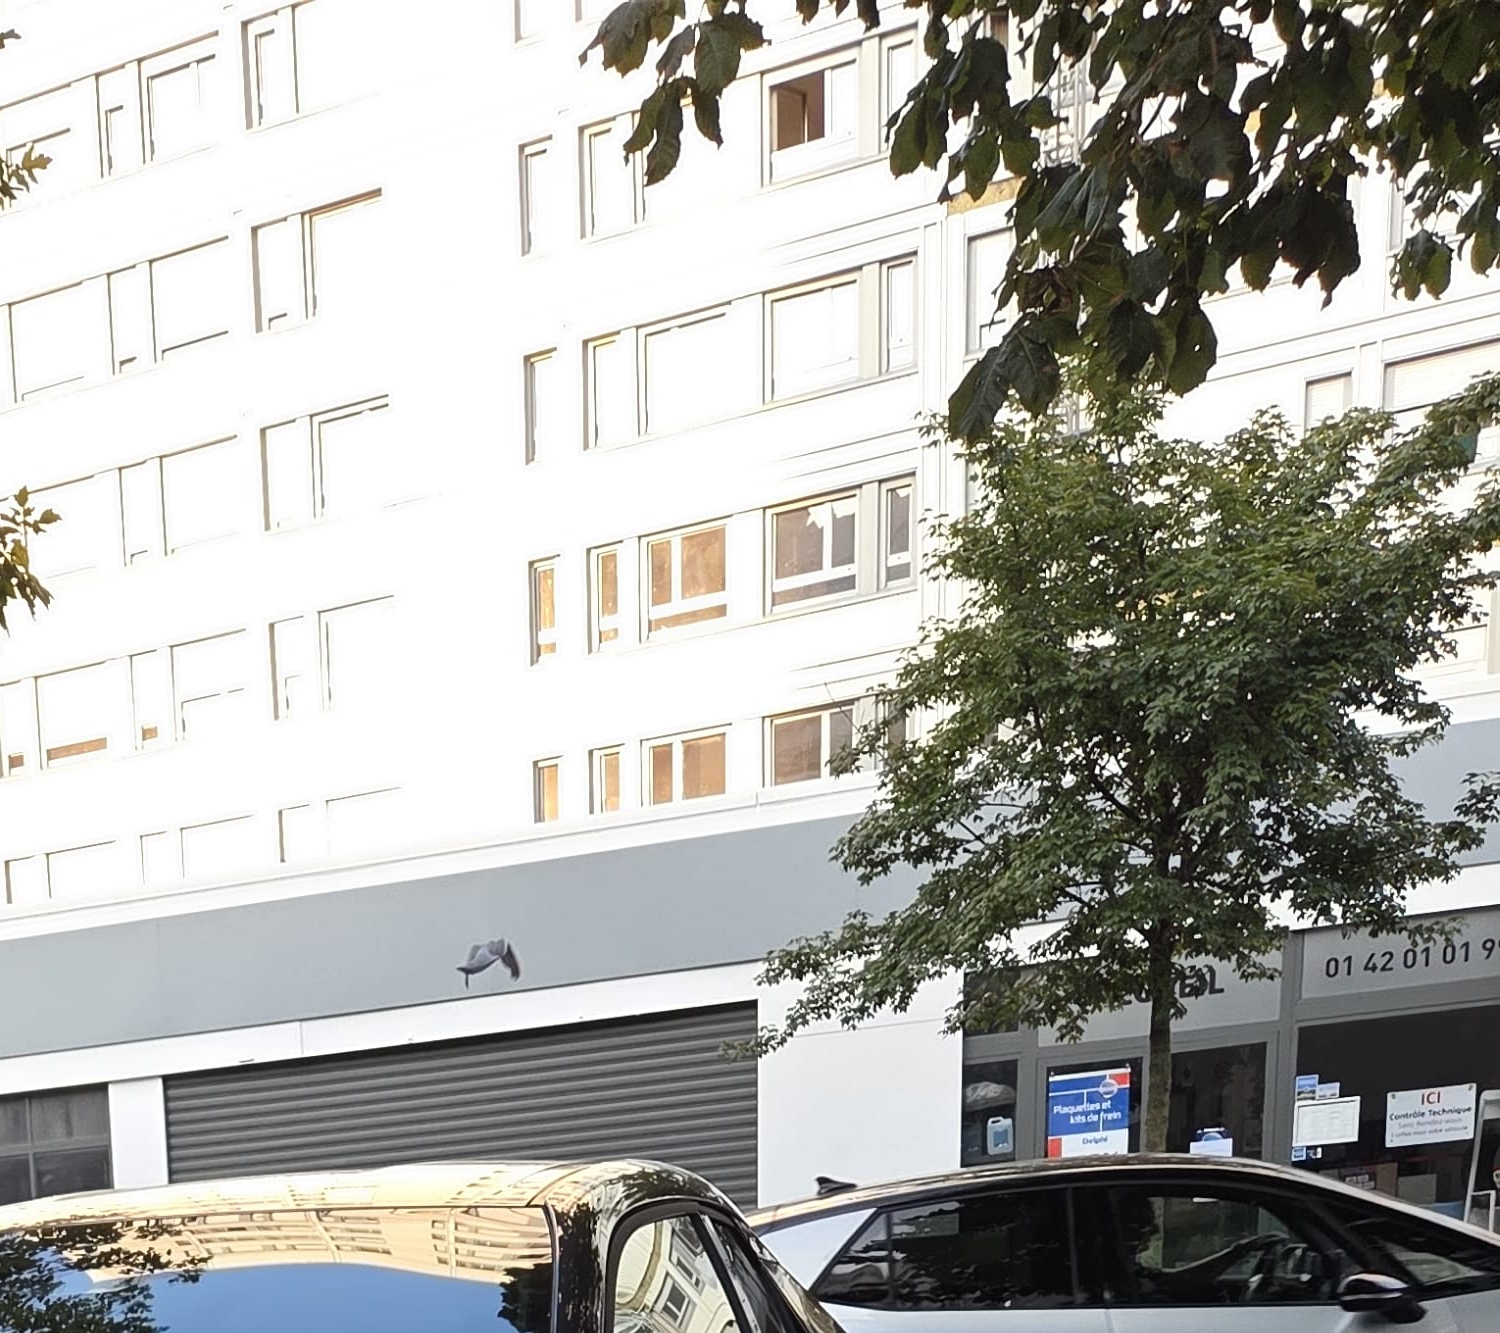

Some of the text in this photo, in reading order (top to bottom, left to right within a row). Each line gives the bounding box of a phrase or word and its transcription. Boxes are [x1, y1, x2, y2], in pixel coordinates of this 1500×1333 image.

[1325, 938, 1500, 978] 01 42 01 01 9
[1421, 1091, 1441, 1106] ICI
[1053, 1100, 1112, 1115] Plaquettes et
[1389, 1106, 1472, 1121] Contrôle Technique
[1069, 1110, 1122, 1124] kits de frein
